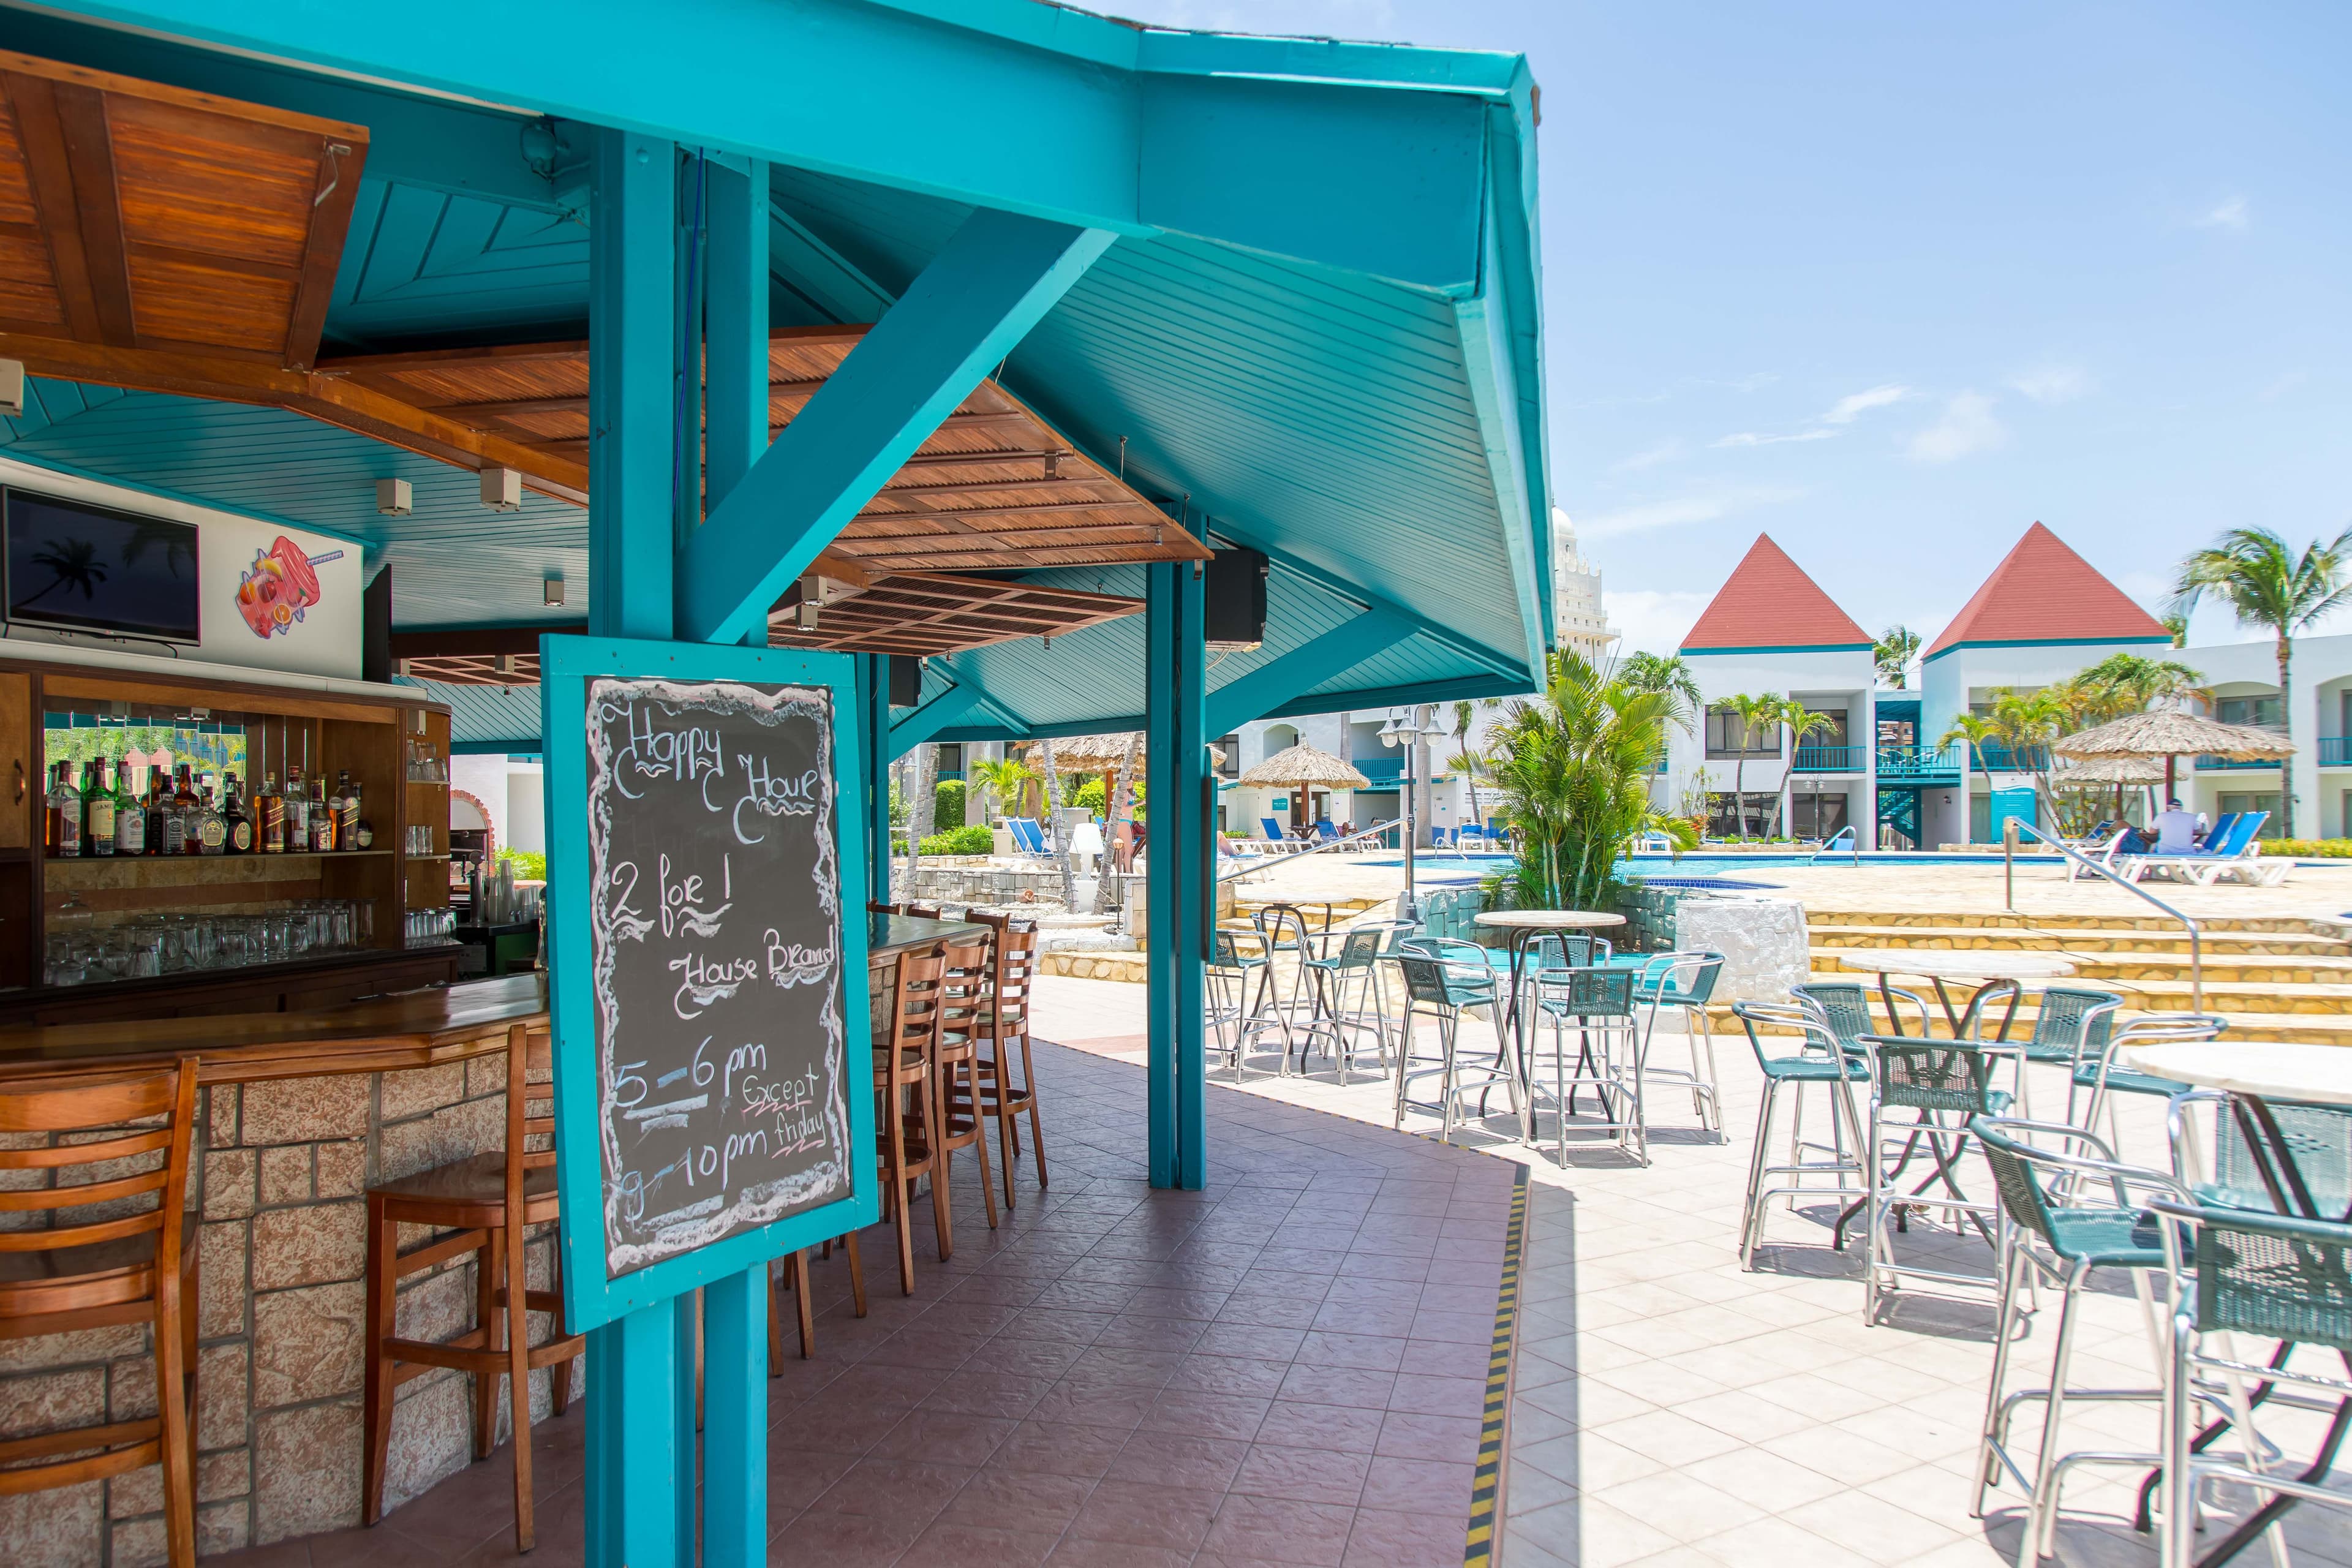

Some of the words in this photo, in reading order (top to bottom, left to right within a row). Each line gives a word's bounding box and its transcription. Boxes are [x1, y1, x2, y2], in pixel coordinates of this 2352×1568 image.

[600, 701, 725, 813] Happy
[733, 753, 818, 845] Hour
[611, 861, 643, 919] 2
[659, 853, 704, 939] for
[723, 853, 732, 899] 1
[668, 952, 758, 1020] House
[763, 924, 835, 974] Brand
[742, 1062, 820, 1112] Except
